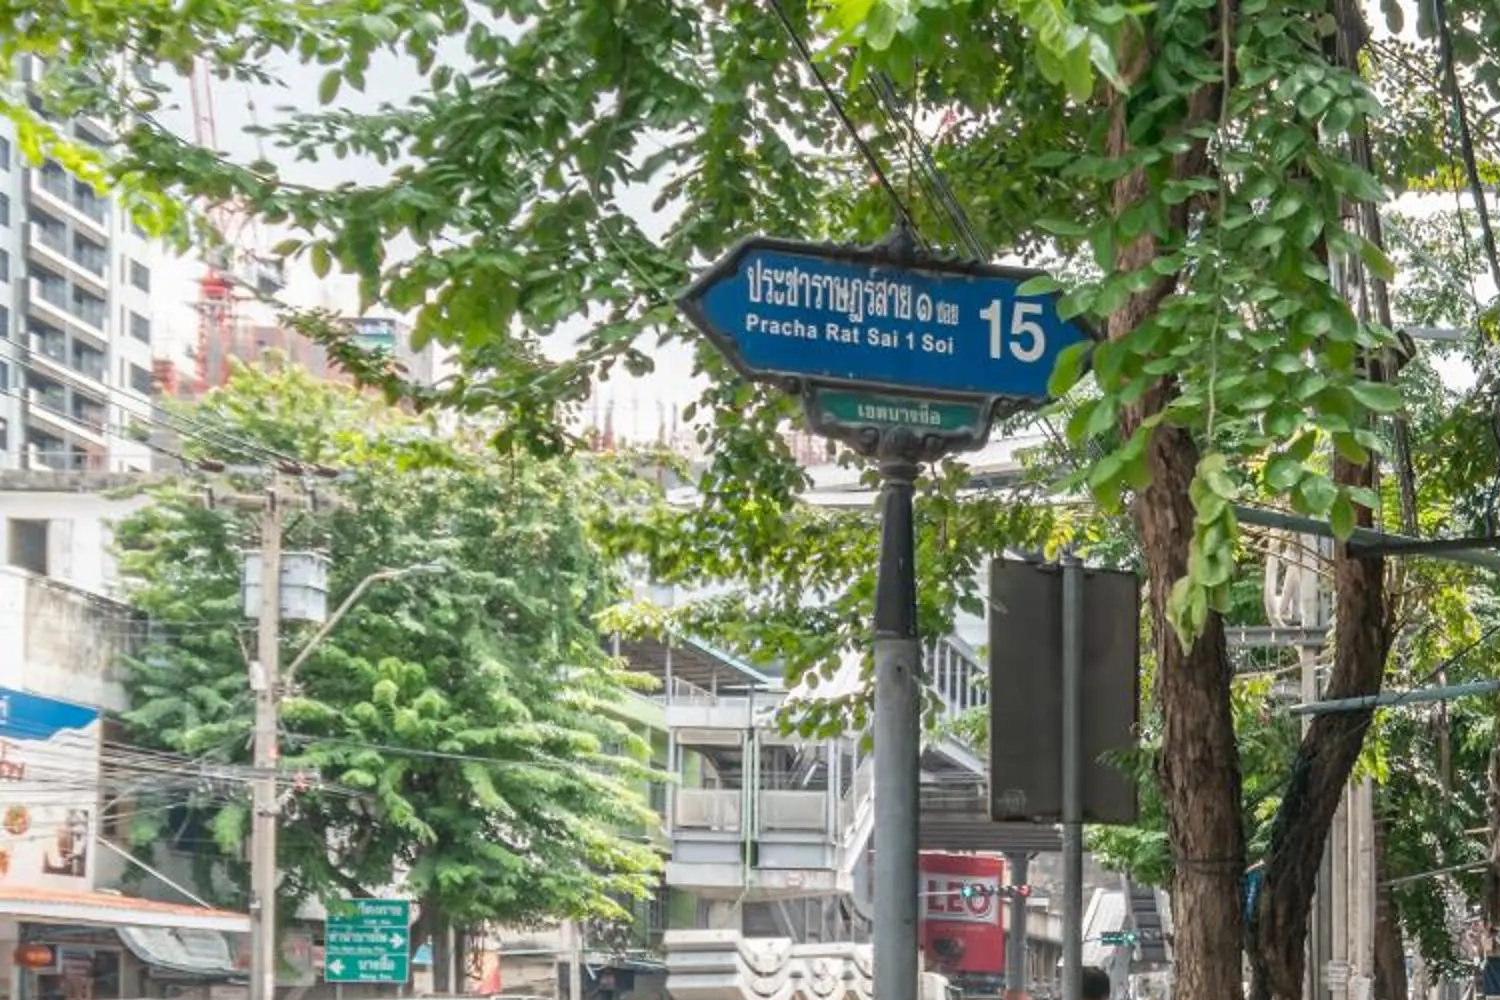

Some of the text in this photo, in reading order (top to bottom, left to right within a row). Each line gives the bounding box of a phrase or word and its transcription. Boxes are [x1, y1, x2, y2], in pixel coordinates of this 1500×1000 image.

[745, 313, 954, 355] Pracha Rat Sai 1 Soi
[979, 298, 1047, 363] 15
[927, 878, 991, 916] LEO
